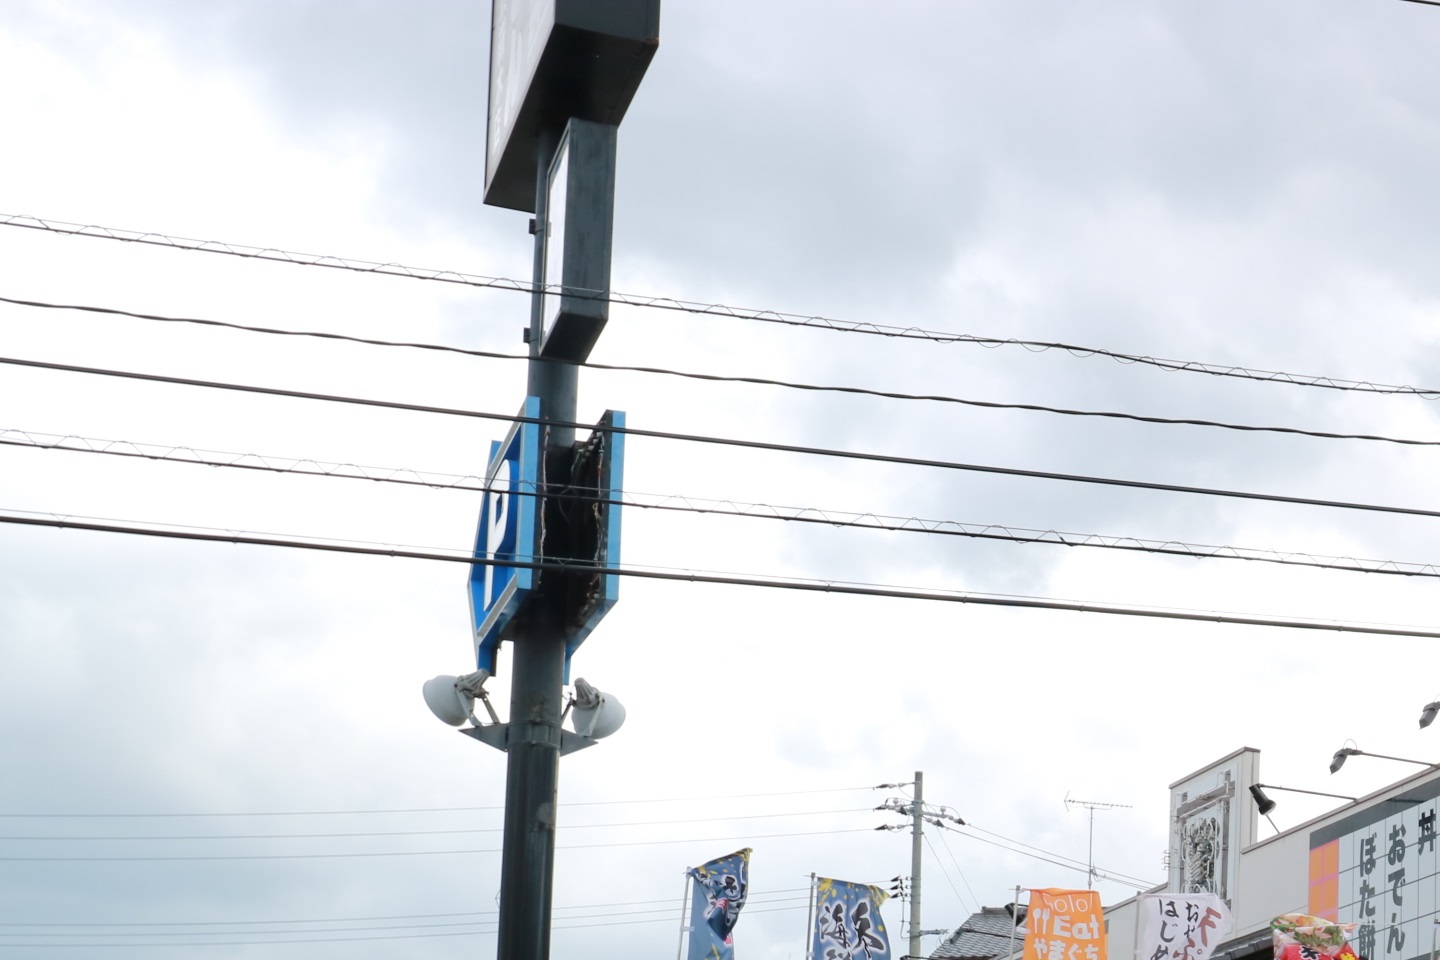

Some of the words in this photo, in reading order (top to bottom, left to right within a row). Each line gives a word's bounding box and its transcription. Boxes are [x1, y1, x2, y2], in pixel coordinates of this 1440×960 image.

[484, 459, 511, 611] P
[1418, 808, 1436, 854] 丼
[1053, 915, 1099, 939] Eat
[1386, 825, 1406, 954] おでん
